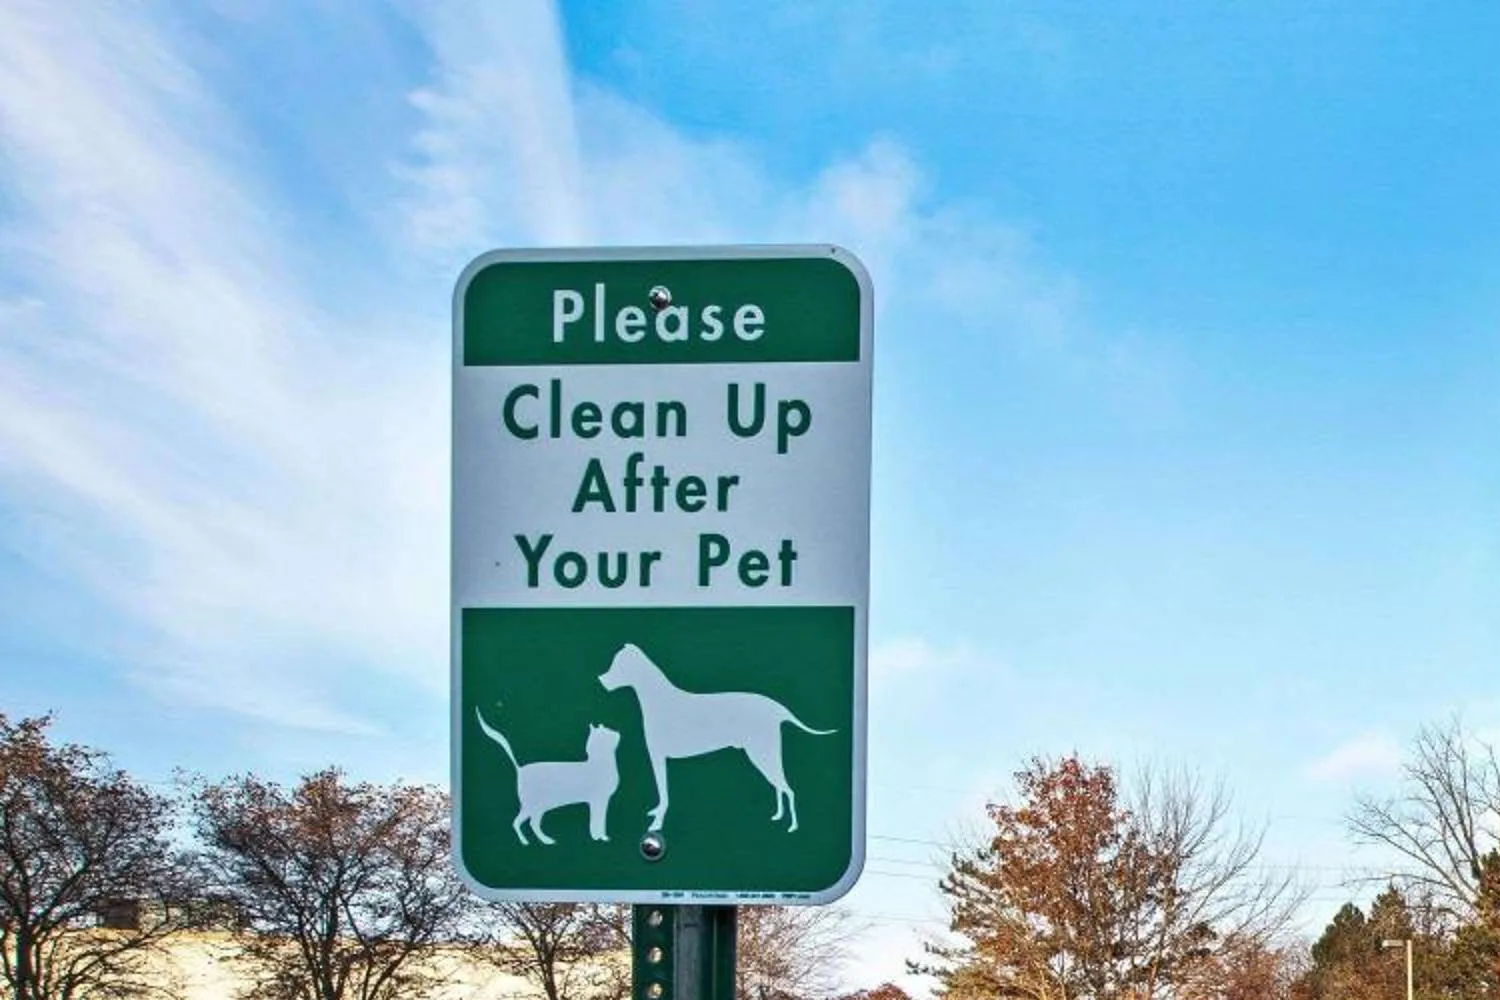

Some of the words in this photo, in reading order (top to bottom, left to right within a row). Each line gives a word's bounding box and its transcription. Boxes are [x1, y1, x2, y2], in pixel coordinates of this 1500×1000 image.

[552, 283, 766, 343] Please
[502, 378, 688, 440] Clean
[727, 382, 812, 454] Up
[571, 452, 740, 513] After
[513, 533, 662, 589] Your
[698, 532, 798, 588] Pet
